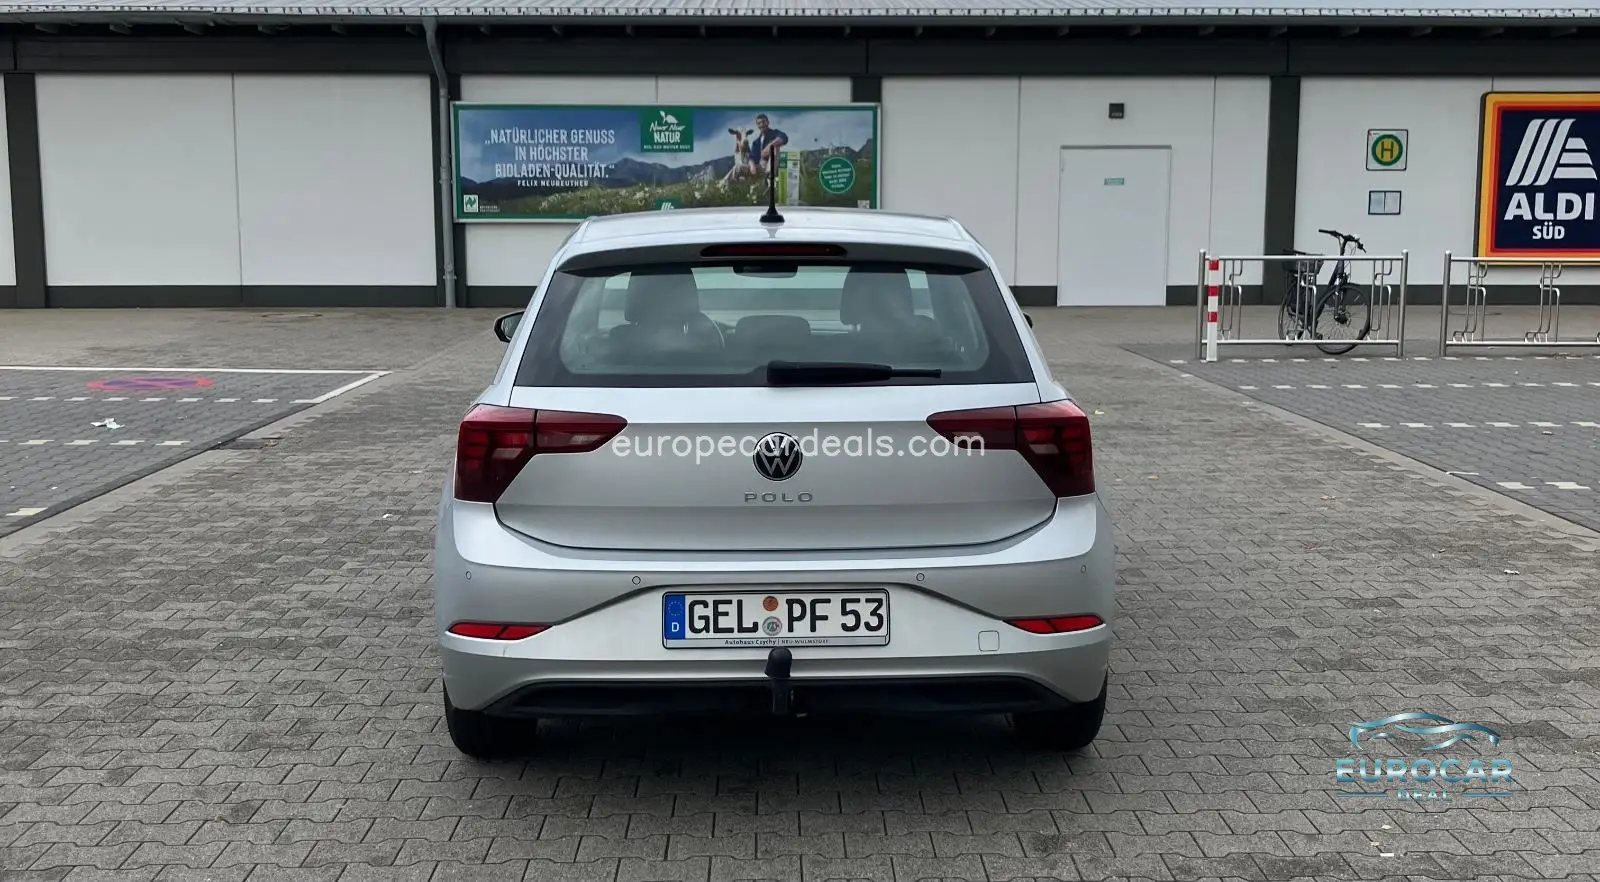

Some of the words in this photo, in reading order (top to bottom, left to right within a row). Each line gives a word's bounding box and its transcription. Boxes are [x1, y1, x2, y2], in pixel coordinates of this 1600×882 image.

[485, 126, 568, 144] „NATÜRLICHER
[570, 129, 615, 144] GENUSS
[653, 131, 681, 144] NATUR
[515, 145, 526, 161] IN
[529, 143, 589, 161] HÖCHSTER
[1380, 140, 1394, 160] H
[1503, 192, 1595, 221] ALDI
[1532, 221, 1565, 240] SÜD
[744, 491, 813, 503] POLO
[671, 622, 680, 632] D
[688, 598, 759, 634] GEL
[785, 598, 832, 633] PF
[840, 597, 884, 632] 53
